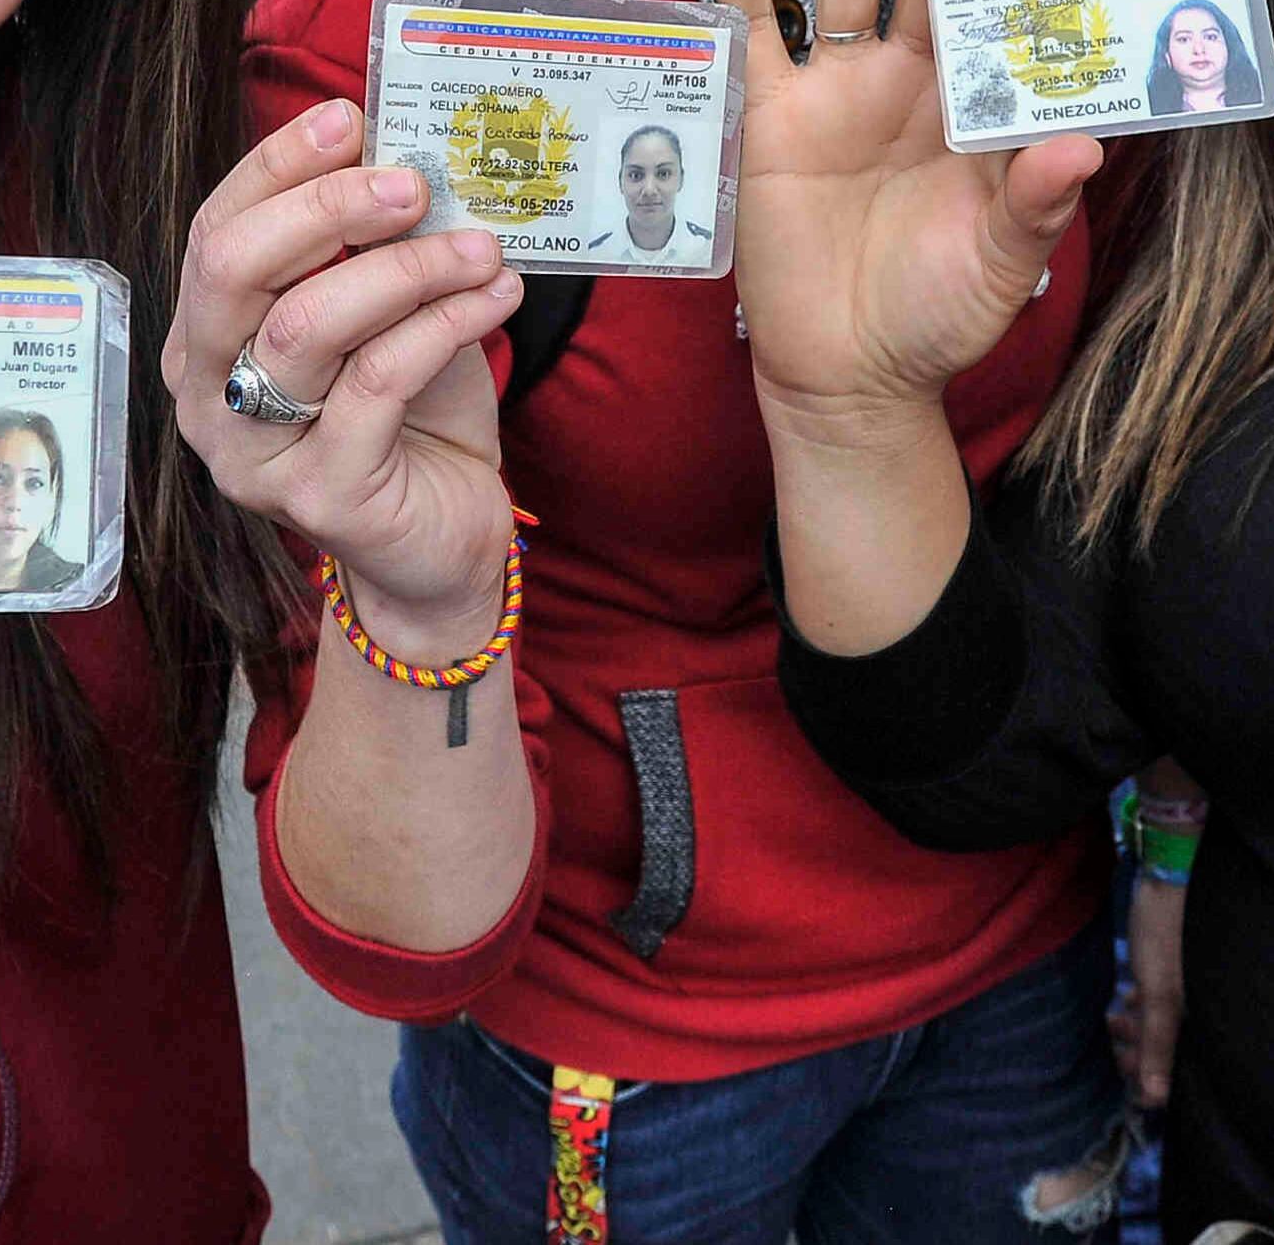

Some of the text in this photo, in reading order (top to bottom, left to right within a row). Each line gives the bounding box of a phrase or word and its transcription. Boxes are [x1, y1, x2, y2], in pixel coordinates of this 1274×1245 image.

[416, 21, 709, 49] REPUBLICA BOLIVARIANA DE VENEZUELA
[1074, 35, 1125, 50] SOLTERA
[439, 45, 678, 69] CEDULA DE IDENTIDAD
[511, 66, 592, 82] V 23.095.347
[662, 73, 707, 89] MF108
[1080, 67, 1127, 82] 10-2021
[430, 81, 544, 99] CAICEDO ROMERO
[653, 89, 712, 103] Juan Dugarte
[429, 99, 520, 115] KELLY JOHANA
[666, 104, 702, 114] Director
[1031, 97, 1142, 122] VENEZOLANO
[384, 115, 420, 138] Kelly
[470, 157, 579, 173] 07-12-92 SOLTERA
[468, 196, 575, 212] 20-05-15 05-2025
[496, 234, 581, 252] EZOLANO
[12, 340, 77, 358] MM615
[0, 361, 79, 376] Juan Dugarte
[18, 378, 66, 390] Director
